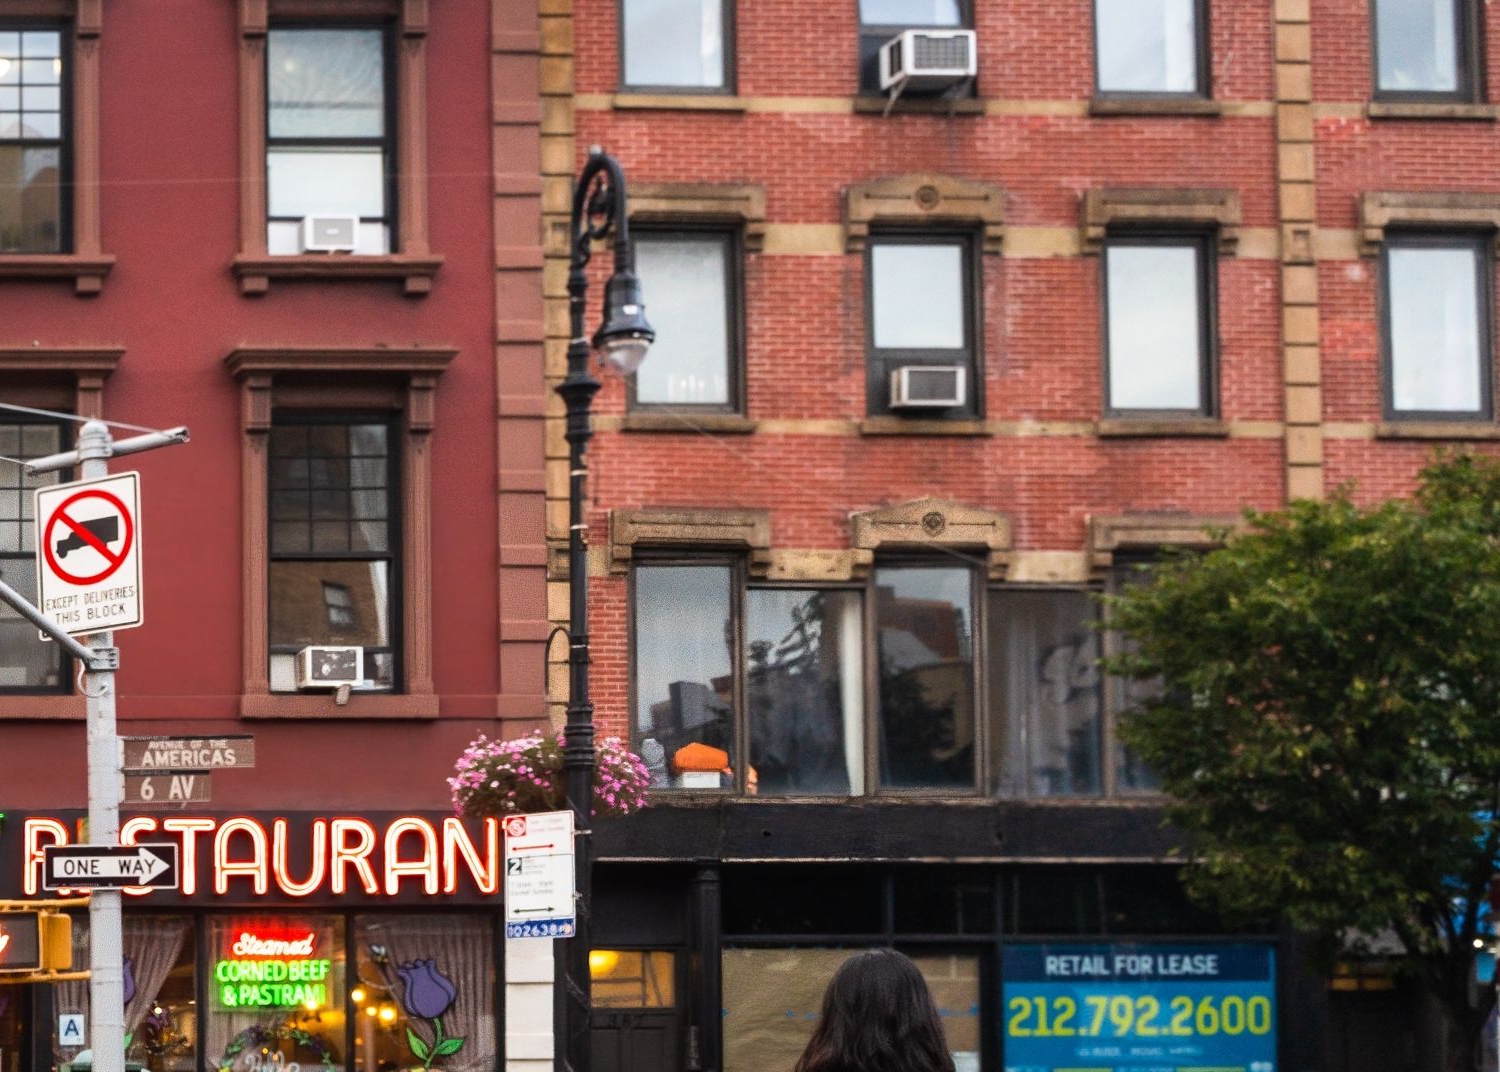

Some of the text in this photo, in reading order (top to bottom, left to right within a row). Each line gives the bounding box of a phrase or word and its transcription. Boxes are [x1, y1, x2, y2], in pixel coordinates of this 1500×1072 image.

[45, 586, 136, 611] EXCEPT DELIVERIES
[55, 603, 126, 625] THIS BLOCK
[142, 749, 236, 767] AMERICAS
[140, 775, 194, 800] 6 AV
[63, 859, 156, 875] ONE WAY
[232, 932, 315, 956] Steamed
[216, 959, 330, 982] CORNED BEEF
[1045, 954, 1219, 976] RETAIL FOR LEASE
[223, 984, 325, 1006] & PASTRAMI
[1008, 995, 1271, 1037] 212.792.2600
[64, 1019, 79, 1036] A
